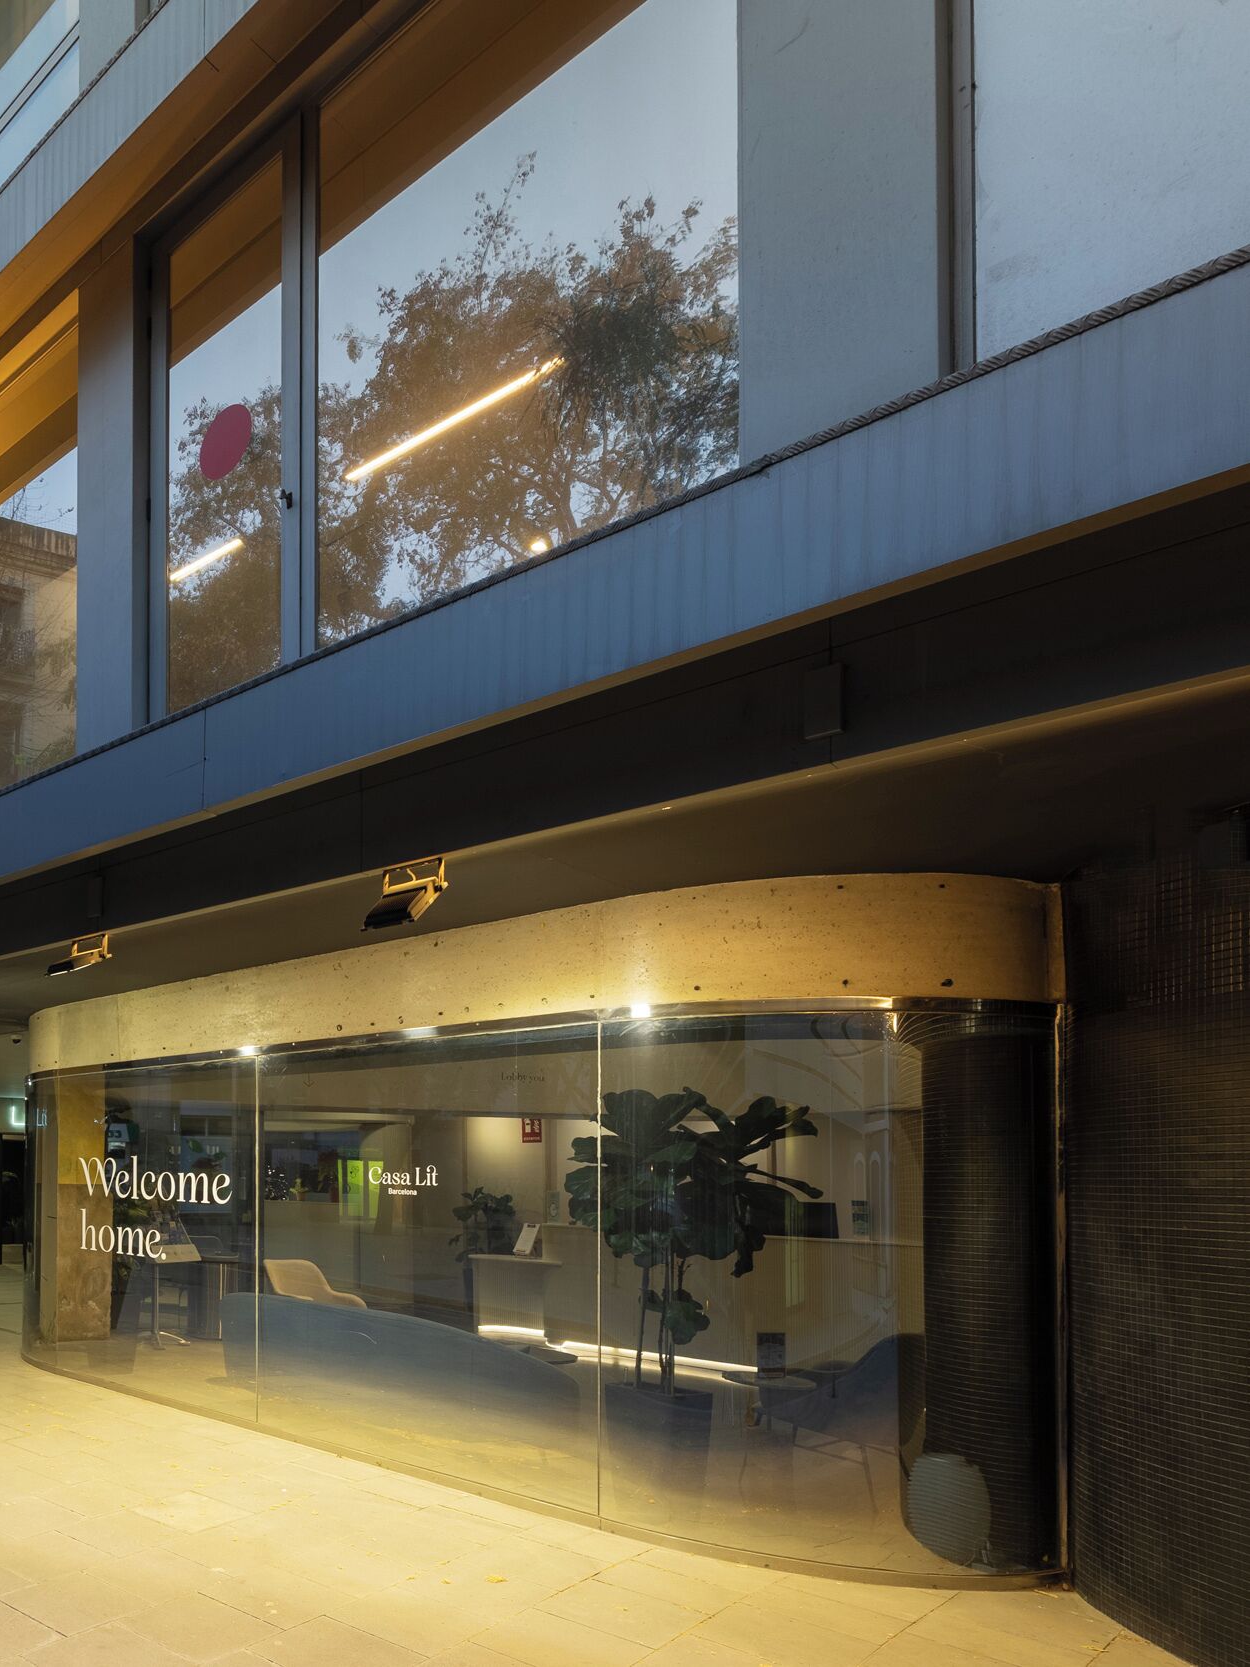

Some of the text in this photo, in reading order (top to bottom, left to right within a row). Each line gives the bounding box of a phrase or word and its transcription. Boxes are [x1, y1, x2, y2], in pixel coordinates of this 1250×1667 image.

[78, 1155, 233, 1205] Welcome
[368, 1164, 439, 1186] Casa Lit
[387, 1187, 418, 1196] Barcelona
[80, 1208, 167, 1261] home.
